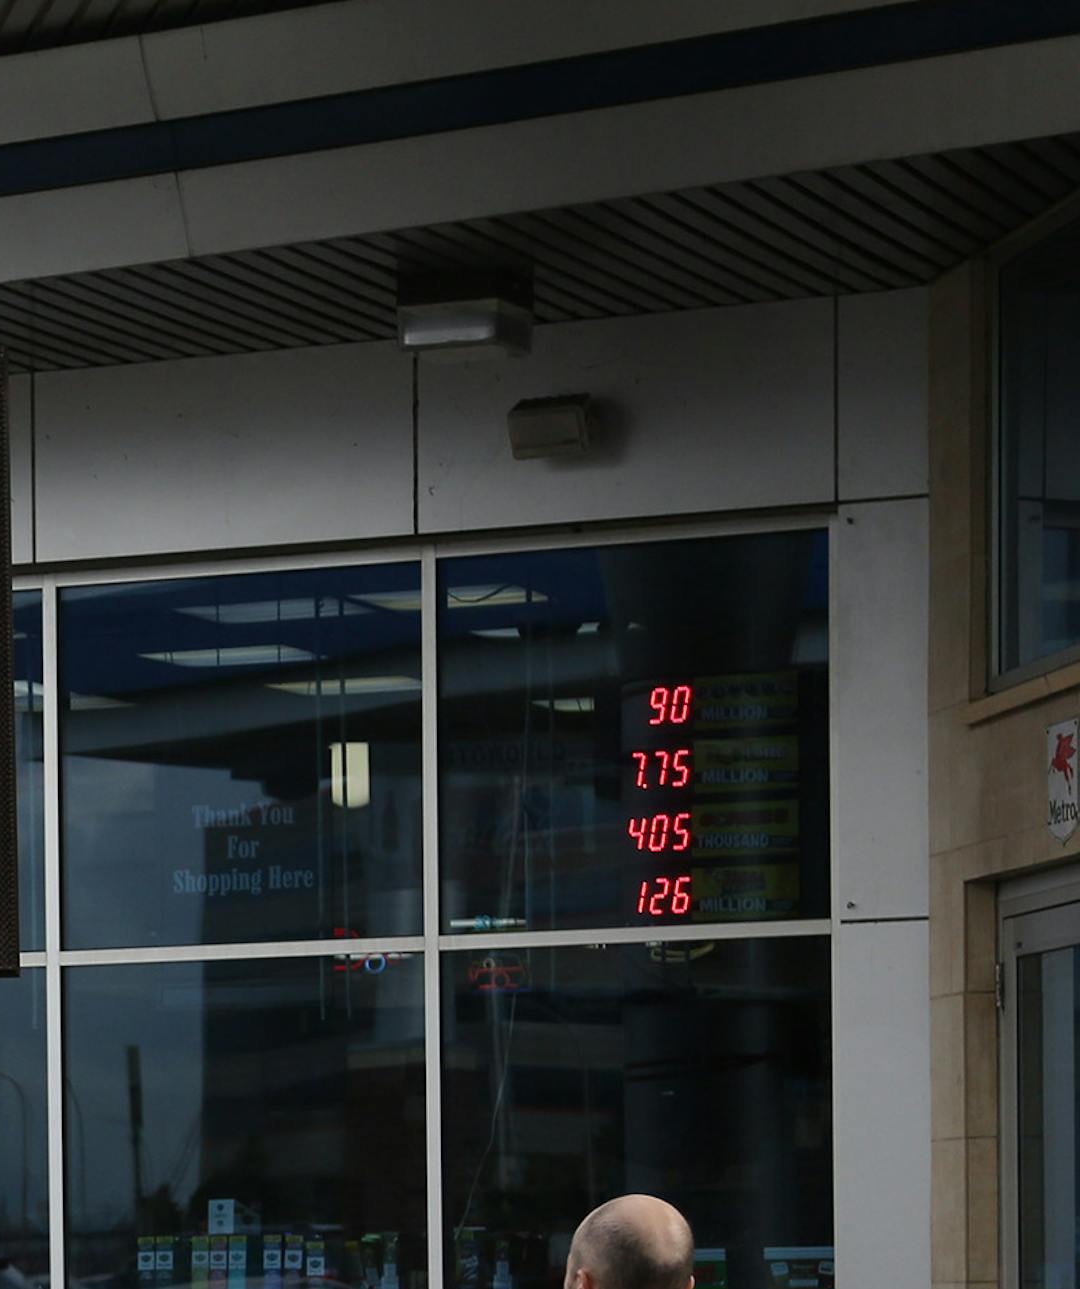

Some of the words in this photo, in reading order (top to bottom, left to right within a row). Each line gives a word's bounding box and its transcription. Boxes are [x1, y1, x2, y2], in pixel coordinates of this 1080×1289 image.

[648, 683, 693, 726] 90
[700, 705, 768, 720] MILLION
[631, 748, 692, 791] 7.75
[701, 768, 769, 784] MILLION
[192, 803, 253, 829] Thank
[257, 801, 296, 826] You
[627, 810, 692, 853] 405
[697, 833, 769, 849] THOUSAND
[227, 835, 260, 860] For
[173, 867, 264, 896] Shopping
[268, 864, 314, 890] Here
[637, 875, 693, 917] 126
[699, 896, 767, 912] MILLION
